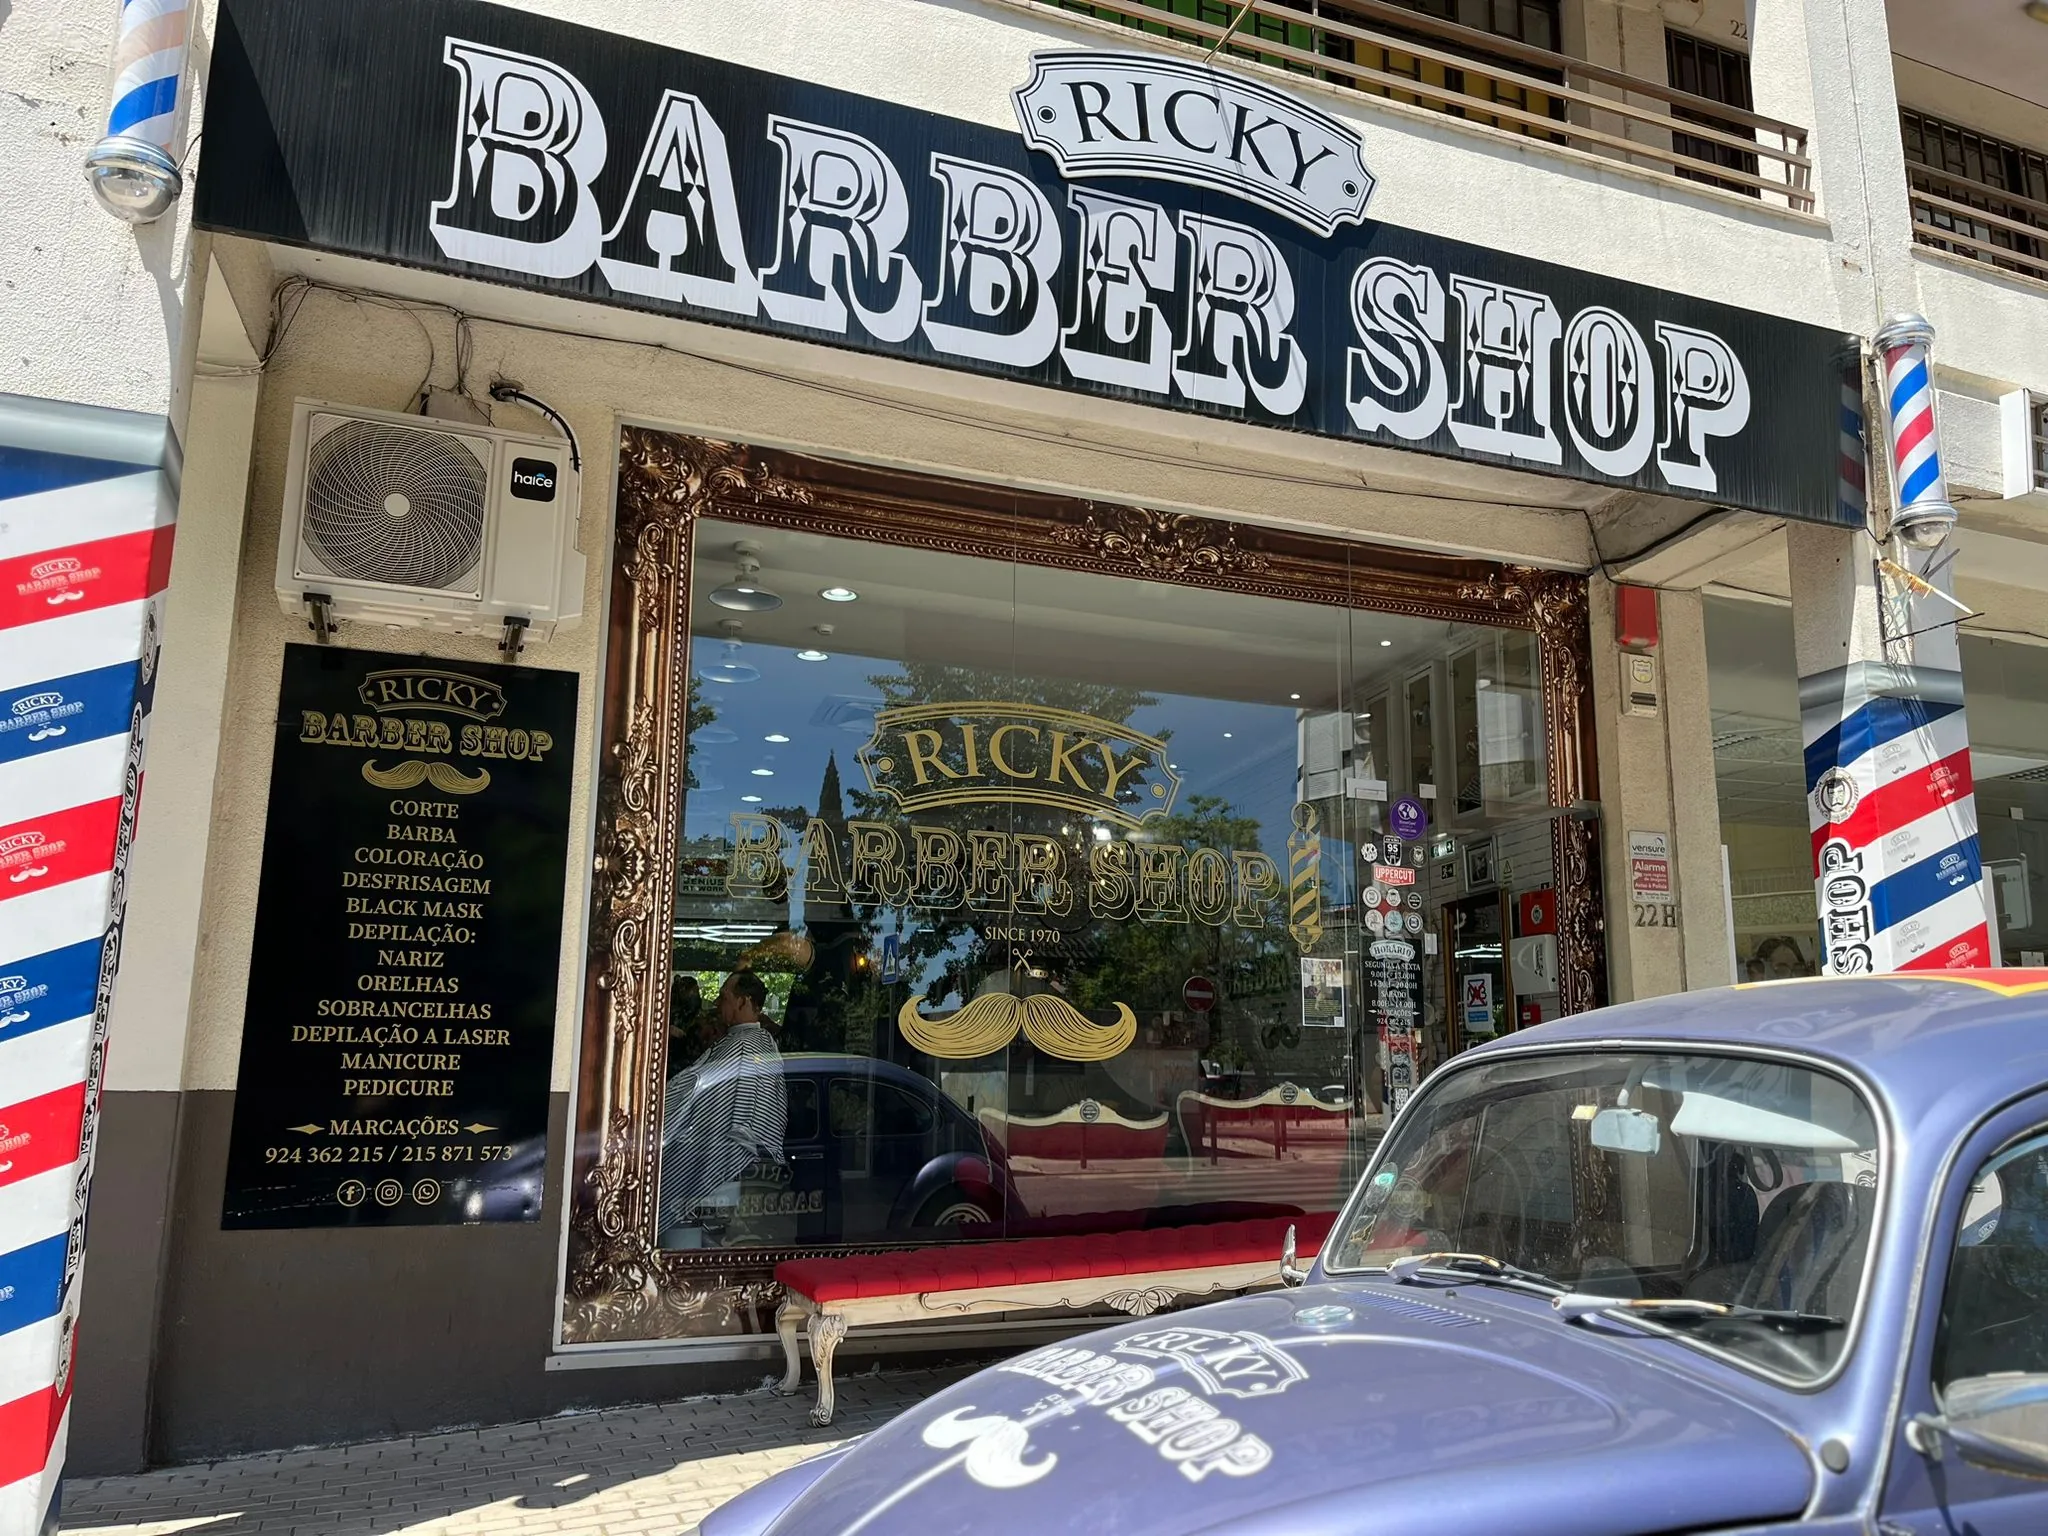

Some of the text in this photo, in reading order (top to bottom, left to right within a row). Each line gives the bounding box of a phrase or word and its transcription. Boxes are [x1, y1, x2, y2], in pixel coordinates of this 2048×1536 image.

[1730, 19, 1748, 40] 22
[1060, 80, 1339, 195] RICKY
[429, 36, 1751, 493] BARBER SHOP
[514, 470, 554, 488] haice
[36, 560, 75, 577] RICKY
[16, 567, 101, 596] BARBER SHOP
[17, 695, 57, 712] RICKY
[376, 677, 492, 711] RICKY
[50, 701, 84, 720] SHOP
[300, 710, 554, 762] BARBER SHOP
[901, 724, 1148, 802] RICKY
[389, 799, 459, 819] CORTE
[0, 835, 38, 853] RICKY
[386, 823, 457, 844] BARBA
[32, 840, 66, 859] SHOP
[1632, 844, 1666, 853] verisure
[354, 847, 484, 872] COLORAÇÃO
[1634, 861, 1666, 872] Alarme
[726, 813, 1282, 928] BARBER SHOP
[1375, 867, 1413, 883] UPPERCUT
[341, 872, 492, 895] DESFRISAGEM
[346, 897, 484, 920] BLACK MASK
[1824, 843, 1873, 974] SHOP
[348, 921, 476, 945] DEPILAÇÃO:
[984, 926, 1061, 944] SINCE 1970
[377, 949, 445, 968] NARIZ
[1374, 944, 1412, 957] HORÁRIO
[14, 984, 48, 1004] SHOP
[357, 974, 459, 994] ORELHAS
[317, 999, 492, 1021] SOBRANCELHAS
[291, 1023, 511, 1048] DEPILAÇÃO A LASER
[340, 1052, 461, 1071] MANICURE
[342, 1079, 454, 1097] PEDICURE
[329, 1116, 459, 1139] MARCAÇÕES
[265, 1145, 513, 1164] 924 362 215 / 215 871 573
[1145, 1332, 1278, 1382] RICKY
[1106, 1386, 1274, 1483] SHOP
